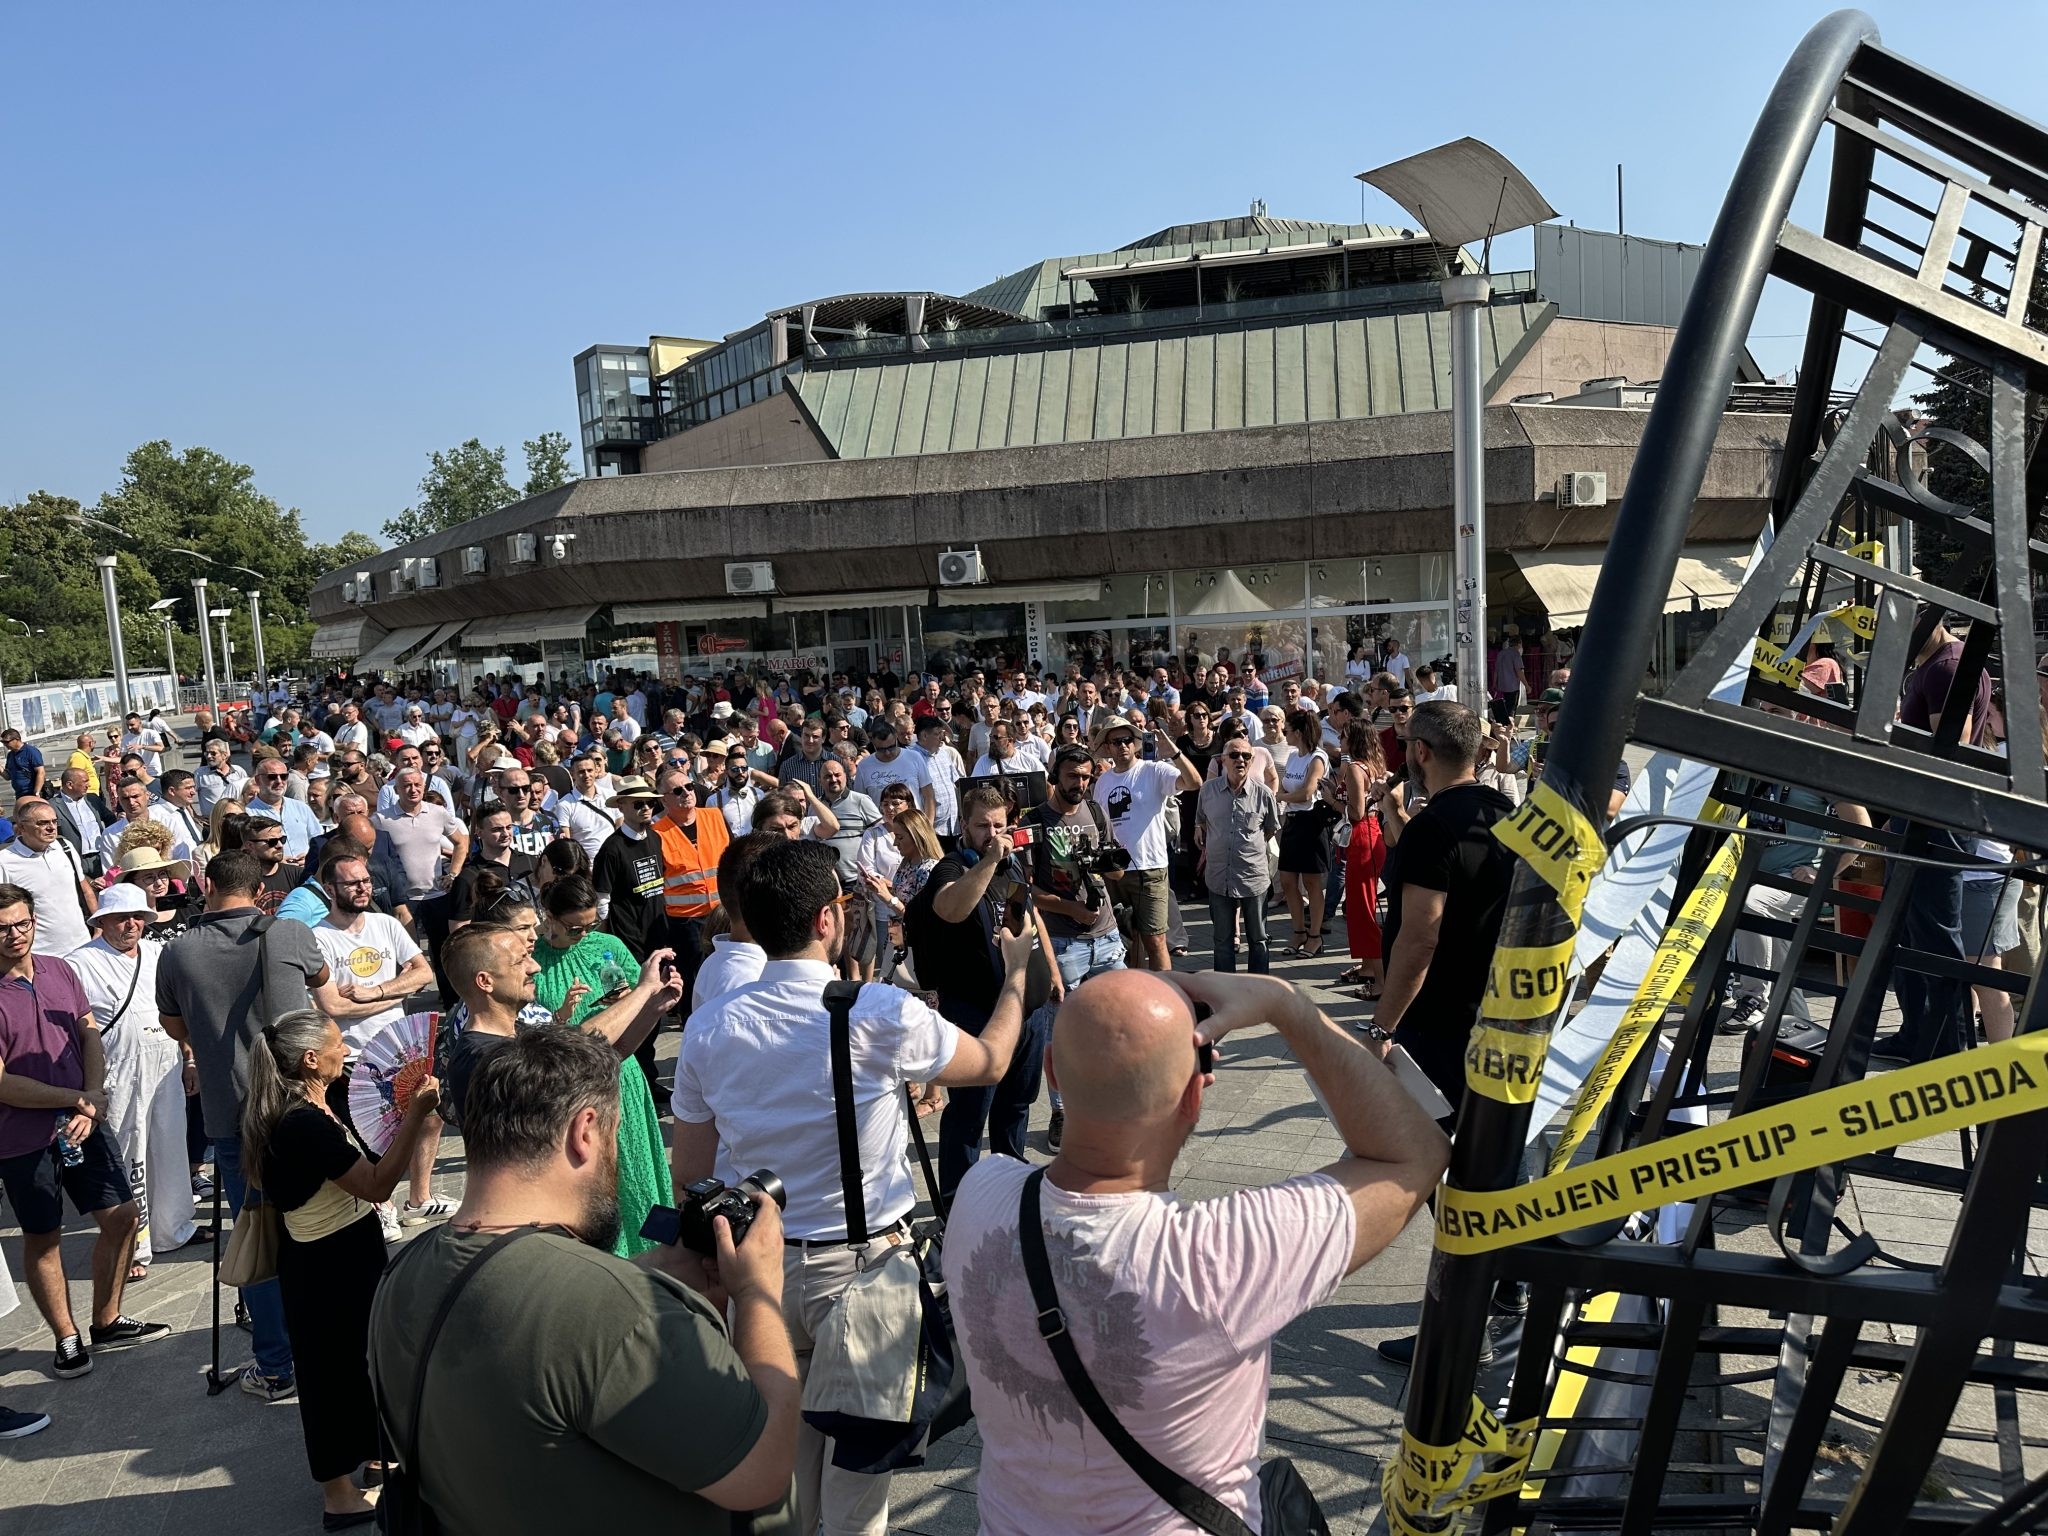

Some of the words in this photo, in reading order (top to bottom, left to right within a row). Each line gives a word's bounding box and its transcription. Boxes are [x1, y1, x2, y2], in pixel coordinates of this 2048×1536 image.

[1028, 603, 1037, 633] ERVIS
[1029, 635, 1039, 659] MOBI
[336, 954, 363, 969] Hard
[365, 947, 392, 964] Rock
[1630, 974, 1671, 1019] POSLANICI
[1657, 953, 1682, 975] STOP
[1629, 1123, 1797, 1195] PRISTUP
[1839, 1060, 2038, 1137] SLOBODA
